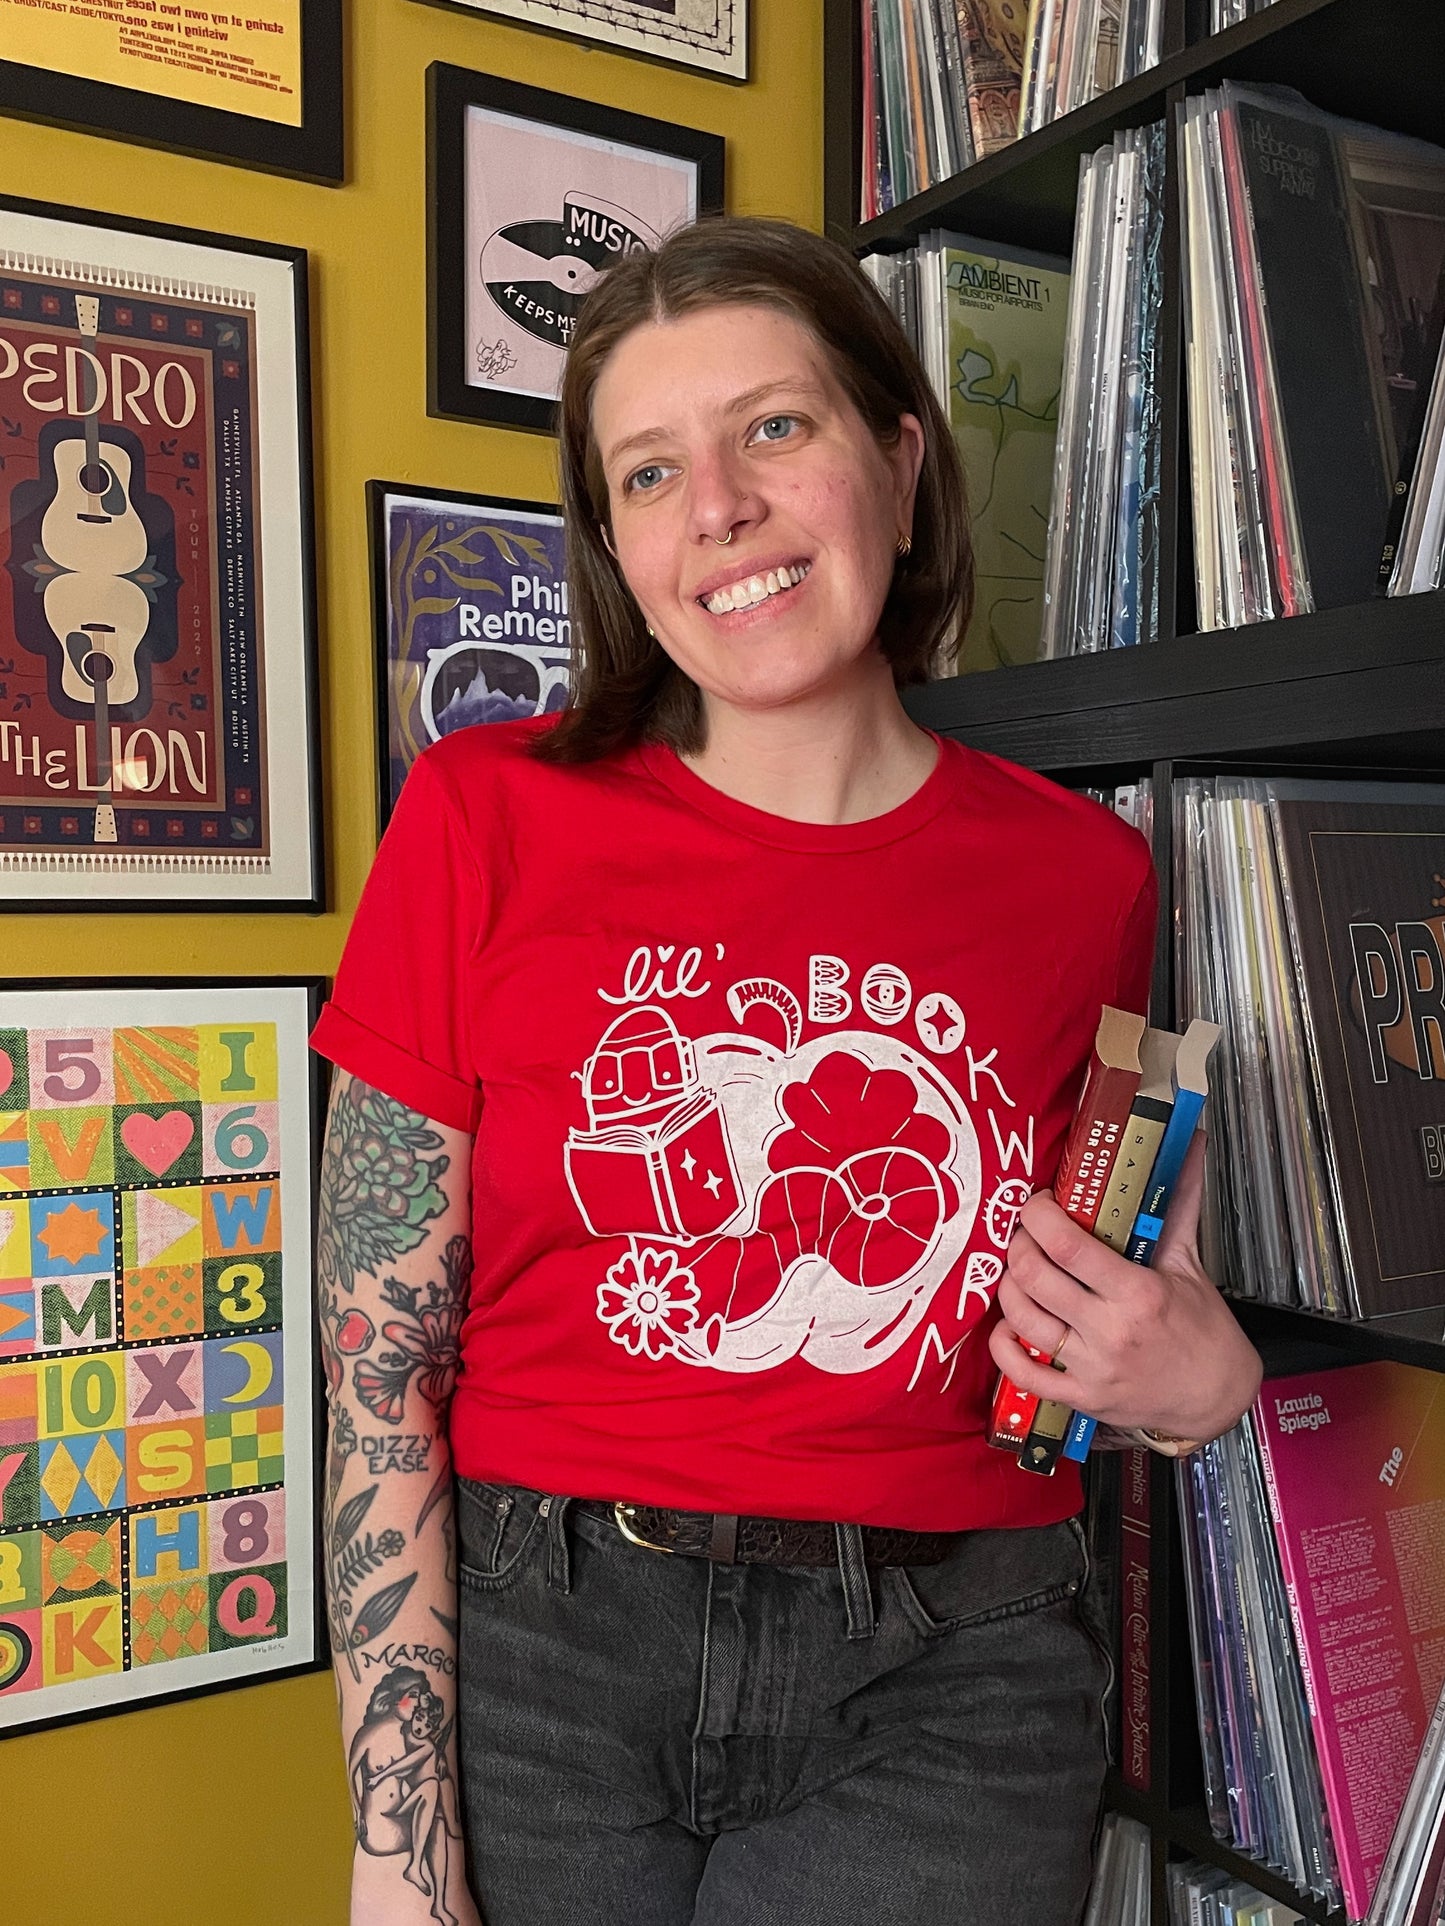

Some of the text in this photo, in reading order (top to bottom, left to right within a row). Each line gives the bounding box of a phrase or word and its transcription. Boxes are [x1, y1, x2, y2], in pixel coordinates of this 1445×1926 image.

[504, 284, 554, 324] KEEPS
[959, 264, 1050, 303] AMBIENT 1
[959, 288, 1043, 312] MUSIC FOR AIRPORTS
[960, 298, 994, 312] BRIAN ENO
[232, 408, 241, 466] GAINESVILLE
[234, 469, 241, 478] FL
[188, 508, 200, 560] TOUR
[224, 456, 230, 468] TX
[228, 596, 235, 608] CO
[238, 607, 245, 617] TN
[76, 724, 207, 794] LION
[243, 753, 249, 763] TX
[44, 1038, 102, 1101] 5
[218, 1032, 256, 1092] I
[36, 1116, 107, 1181] V
[214, 1106, 269, 1170] 6
[1066, 1120, 1104, 1212] FOR OLD MEN
[1082, 1123, 1120, 1216] NO COUNTRY
[209, 1187, 272, 1250] W
[1150, 1186, 1166, 1213] Thoreau
[41, 1278, 112, 1346] M
[218, 1263, 267, 1324] 3
[44, 1360, 117, 1434] 10
[132, 1350, 197, 1419] X
[1275, 1393, 1323, 1415] Laurie
[361, 1434, 432, 1456] DIZZY
[996, 1432, 1024, 1444] VINTAGE
[1074, 1418, 1088, 1443] DOVER
[1278, 1408, 1331, 1434] Spiegel
[137, 1430, 194, 1493] S
[368, 1454, 430, 1475] EASE
[1378, 1445, 1404, 1487] The
[135, 1510, 200, 1579] H
[222, 1500, 270, 1564] 8
[216, 1574, 278, 1638] Q
[1126, 1560, 1149, 1610] Mellon
[1260, 1444, 1316, 1718] Laurie Spiegel The Expanding Universe
[54, 1604, 116, 1676] K
[1126, 1612, 1150, 1647] Collie
[1131, 1668, 1149, 1714] Infinite
[1127, 1707, 1150, 1778] Sadness
